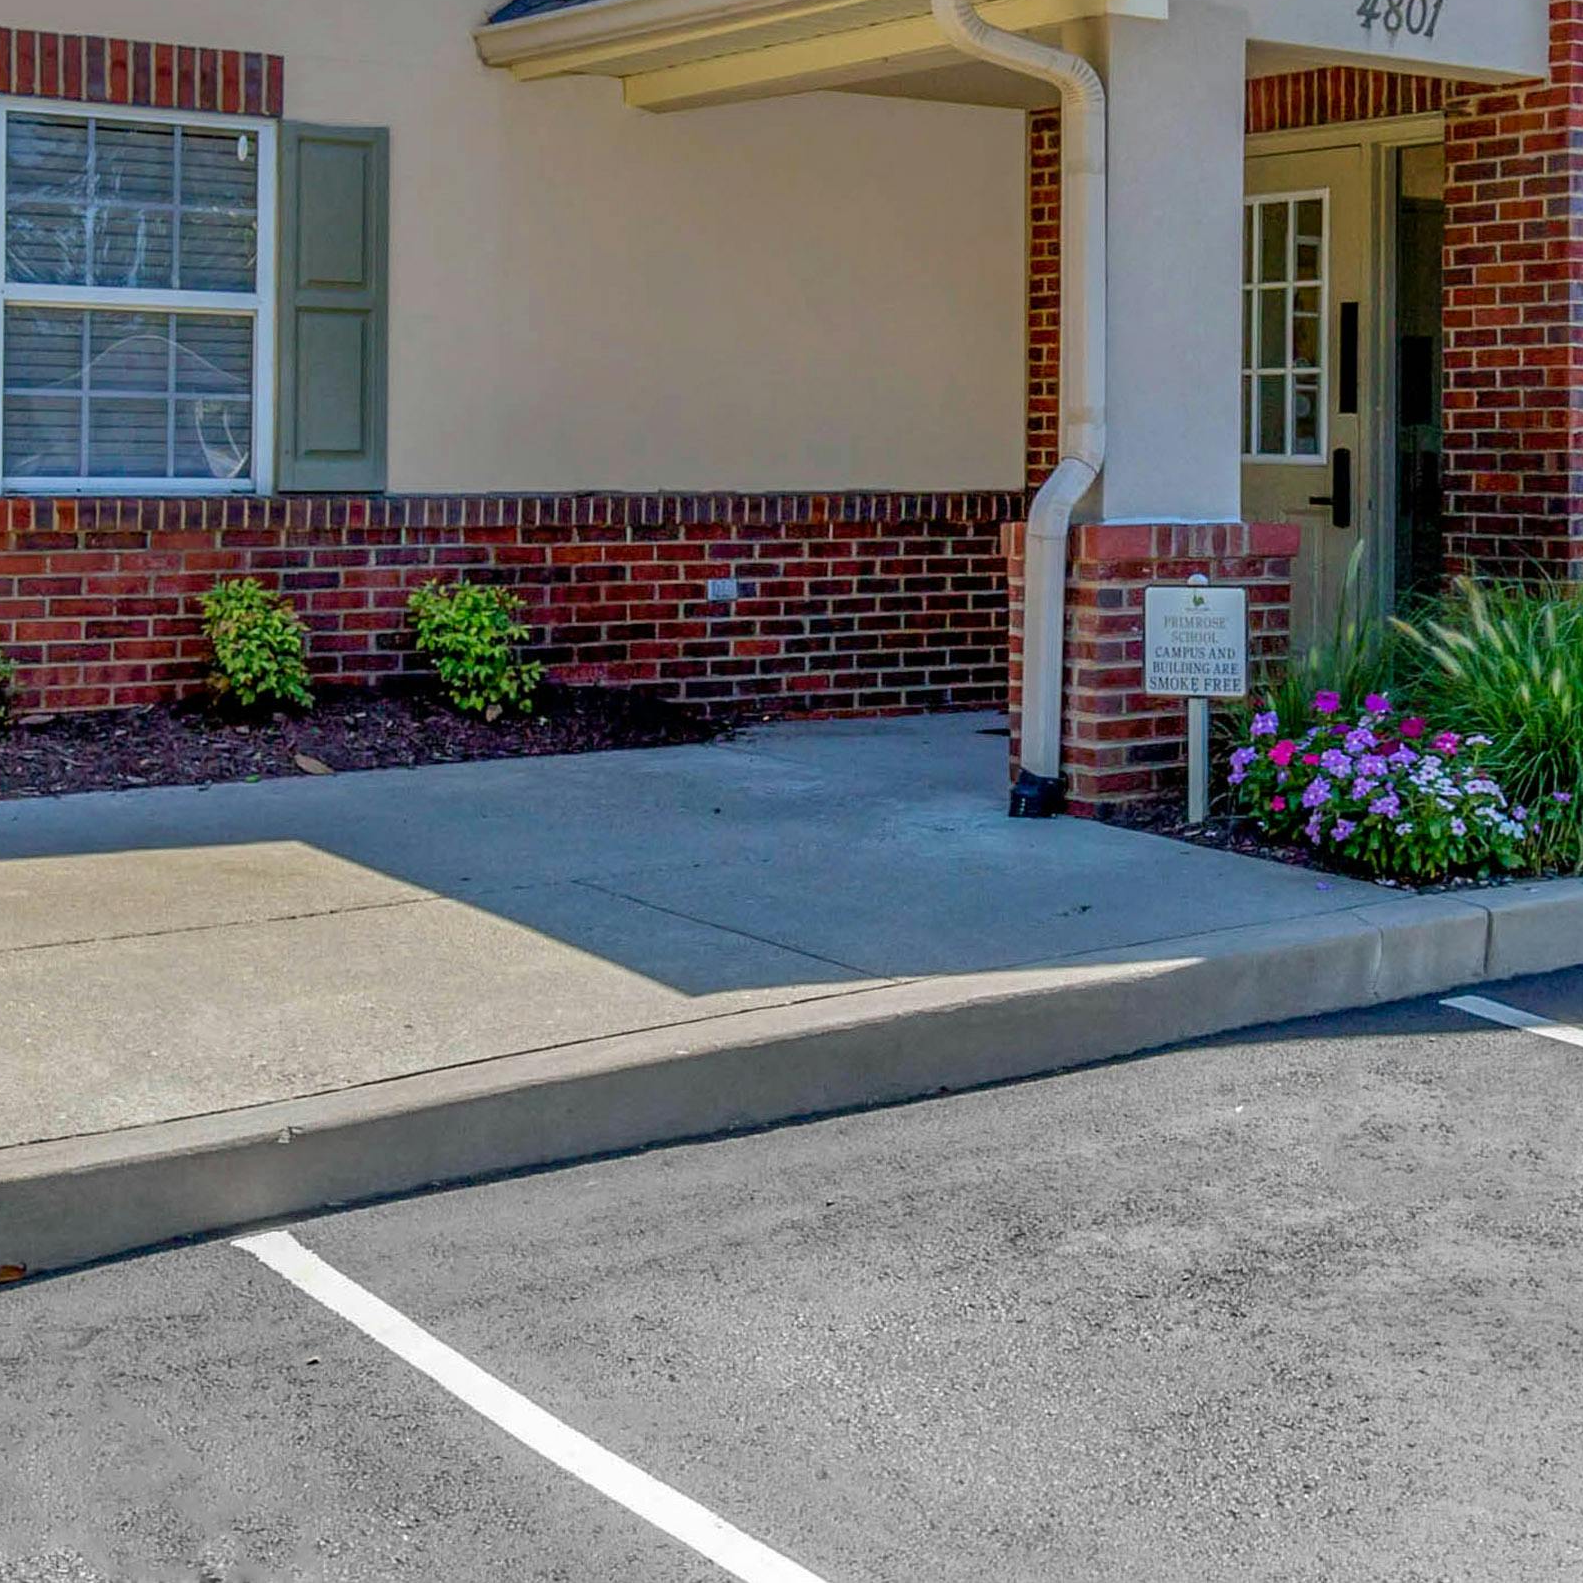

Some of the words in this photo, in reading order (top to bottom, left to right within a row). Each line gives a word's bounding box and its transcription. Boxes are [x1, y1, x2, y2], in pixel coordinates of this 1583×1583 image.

[1164, 616, 1226, 629] PRIMROSE
[1171, 630, 1218, 644] SCHOOL
[1154, 646, 1206, 659] CAMPUS
[1208, 647, 1236, 659] AND
[1152, 661, 1210, 674] BUILDING
[1211, 662, 1239, 674] ARE
[1149, 676, 1199, 691] SMOKE
[1204, 677, 1242, 692] FREE
